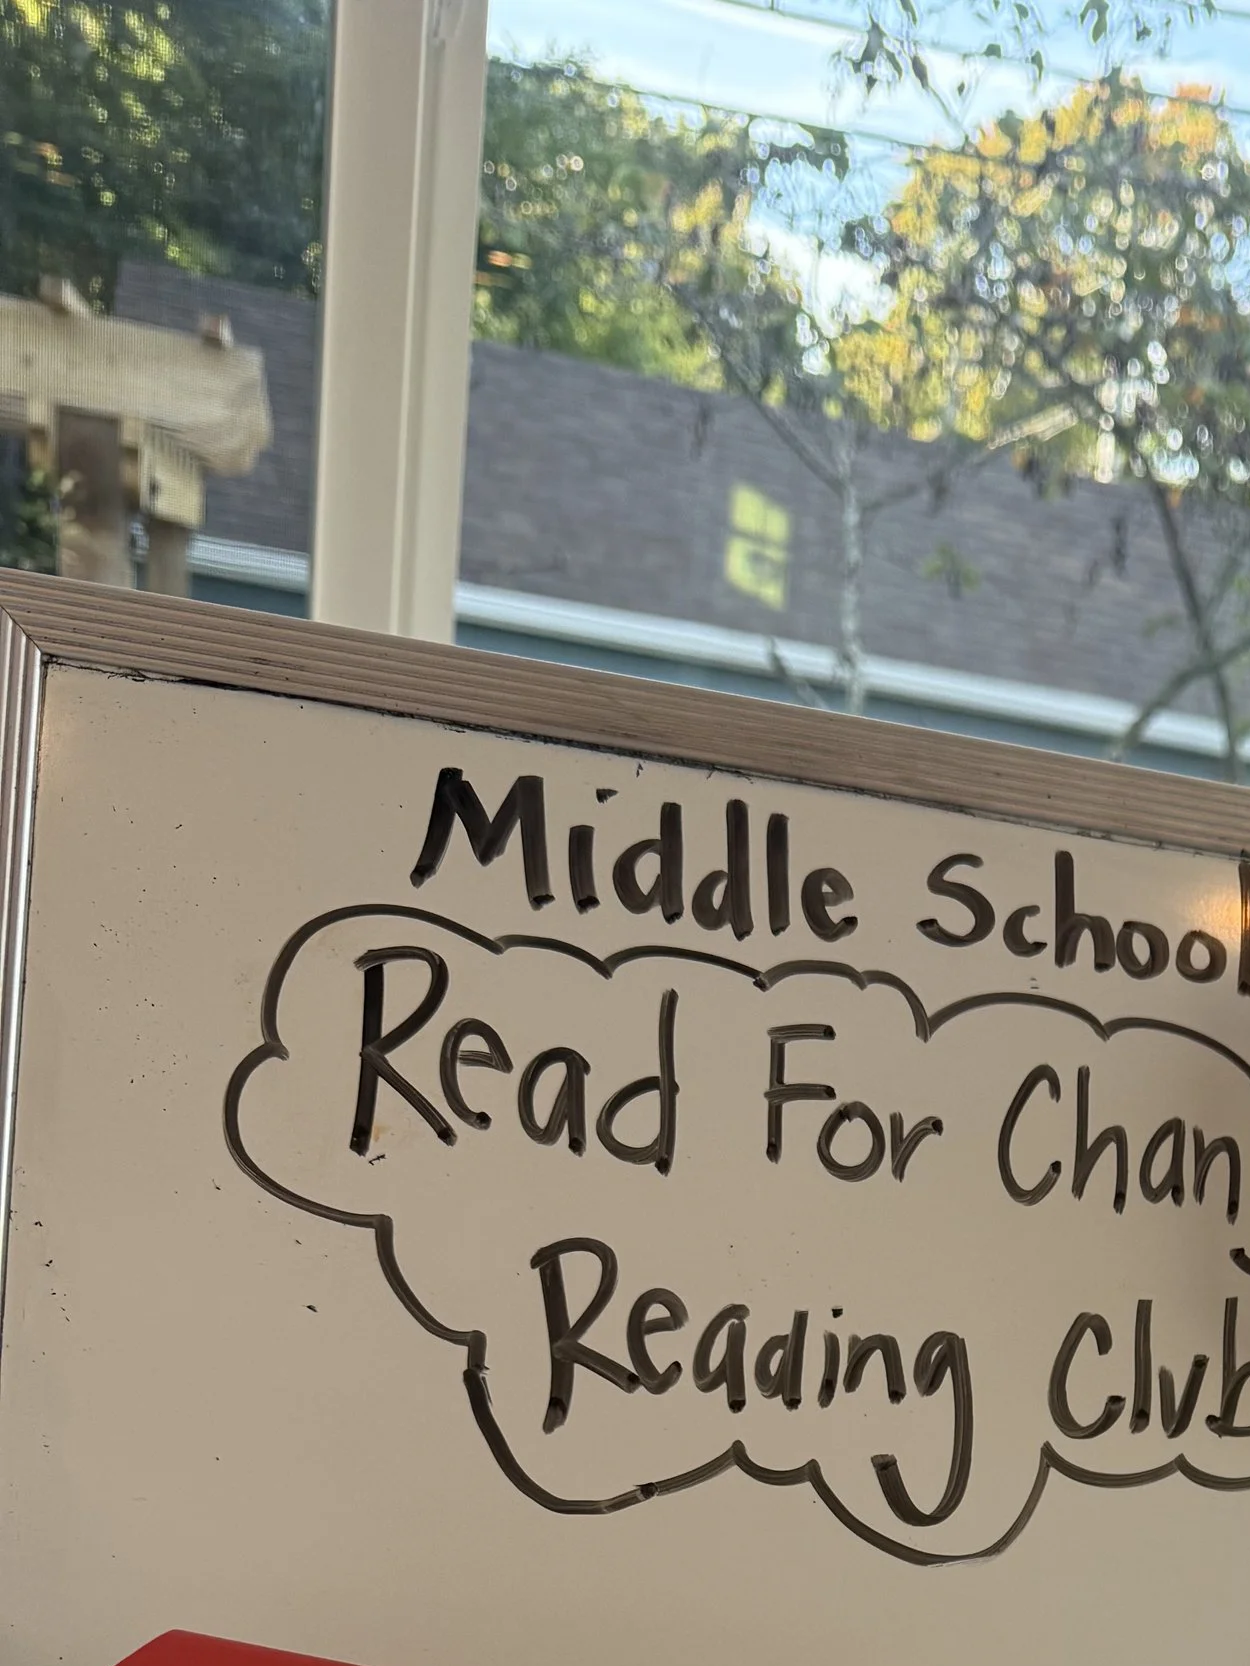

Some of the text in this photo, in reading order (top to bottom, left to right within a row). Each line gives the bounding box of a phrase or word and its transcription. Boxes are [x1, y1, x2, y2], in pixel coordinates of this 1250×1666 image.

[408, 764, 857, 941] Middle
[349, 945, 682, 1178] Read
[766, 1023, 945, 1183] For
[529, 1235, 976, 1528] Reading
